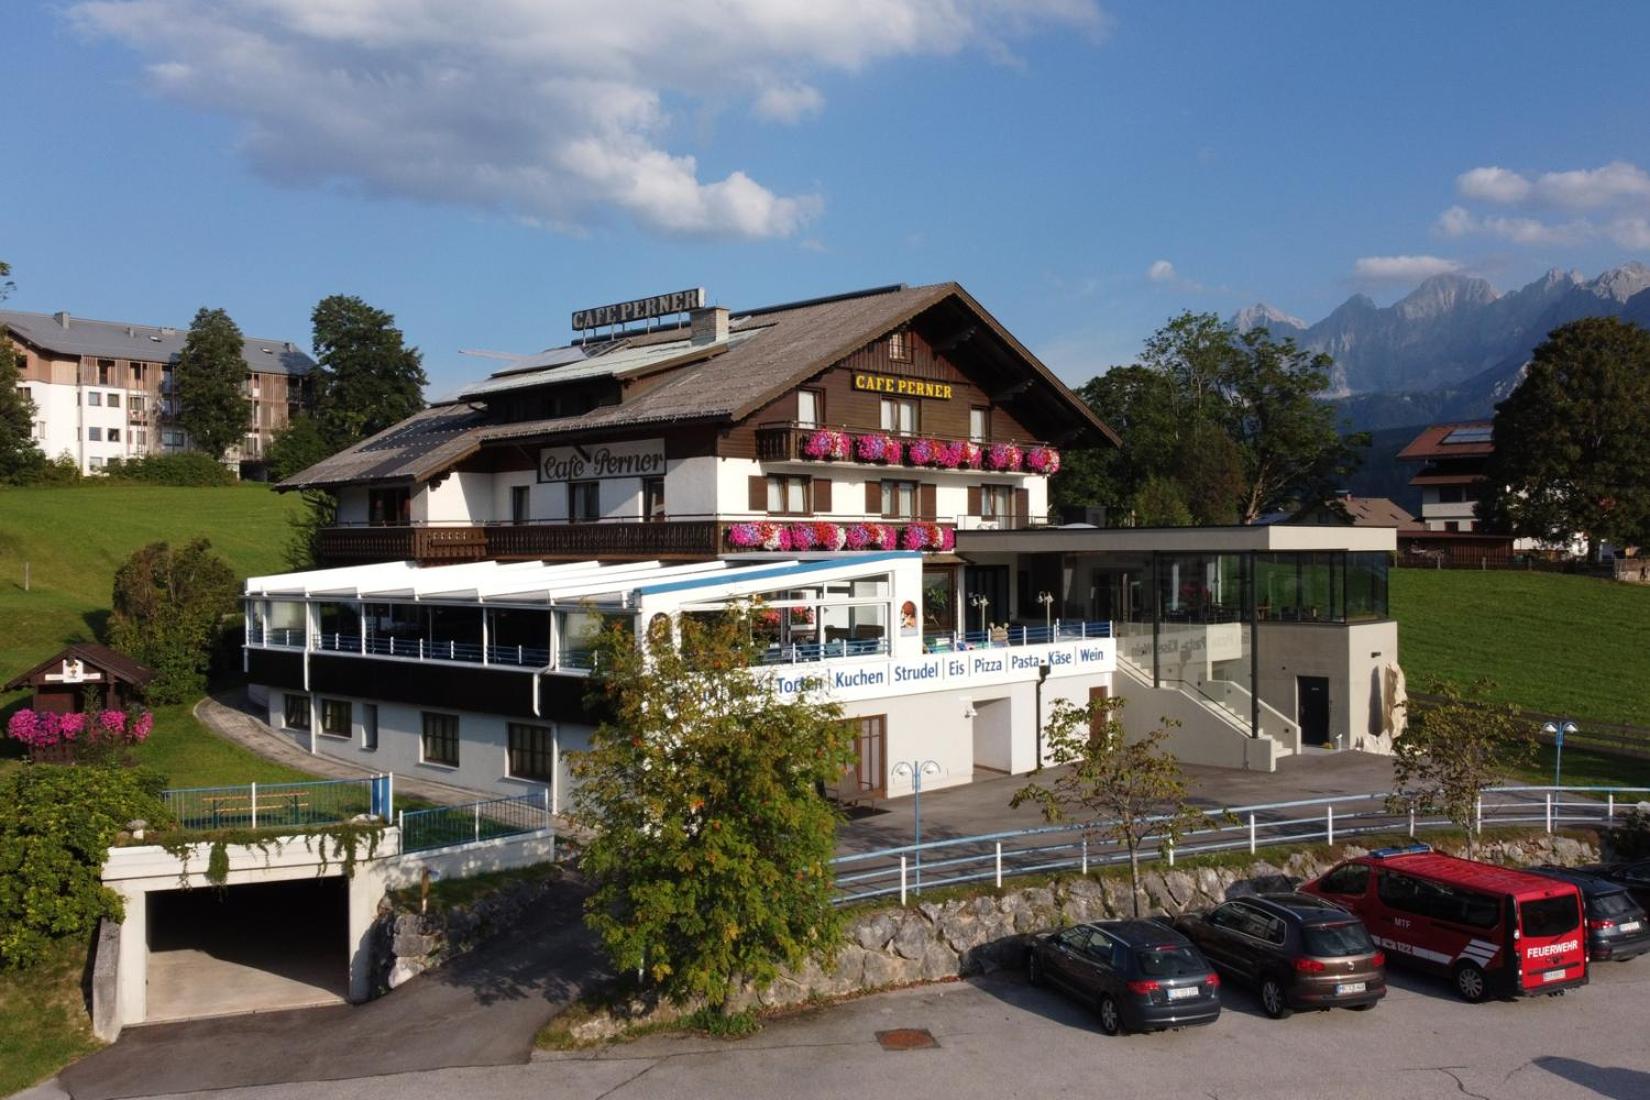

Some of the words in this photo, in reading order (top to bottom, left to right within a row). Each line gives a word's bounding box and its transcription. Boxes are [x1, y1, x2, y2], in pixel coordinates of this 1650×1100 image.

[573, 306, 616, 328] CAFE
[620, 292, 697, 320] PERNER
[855, 374, 894, 393] CAFE
[897, 379, 952, 399] PERNER
[593, 447, 663, 475] Perner
[835, 668, 884, 688] Kuchen
[894, 662, 939, 682] Strudel
[949, 661, 965, 676] Eis
[974, 658, 1003, 673] Pizza
[1011, 654, 1039, 670] Pasta
[1048, 650, 1072, 666] Käse
[1080, 648, 1104, 663] Wein
[1394, 917, 1412, 929] MTF
[1527, 939, 1579, 959] FEUERWEHR
